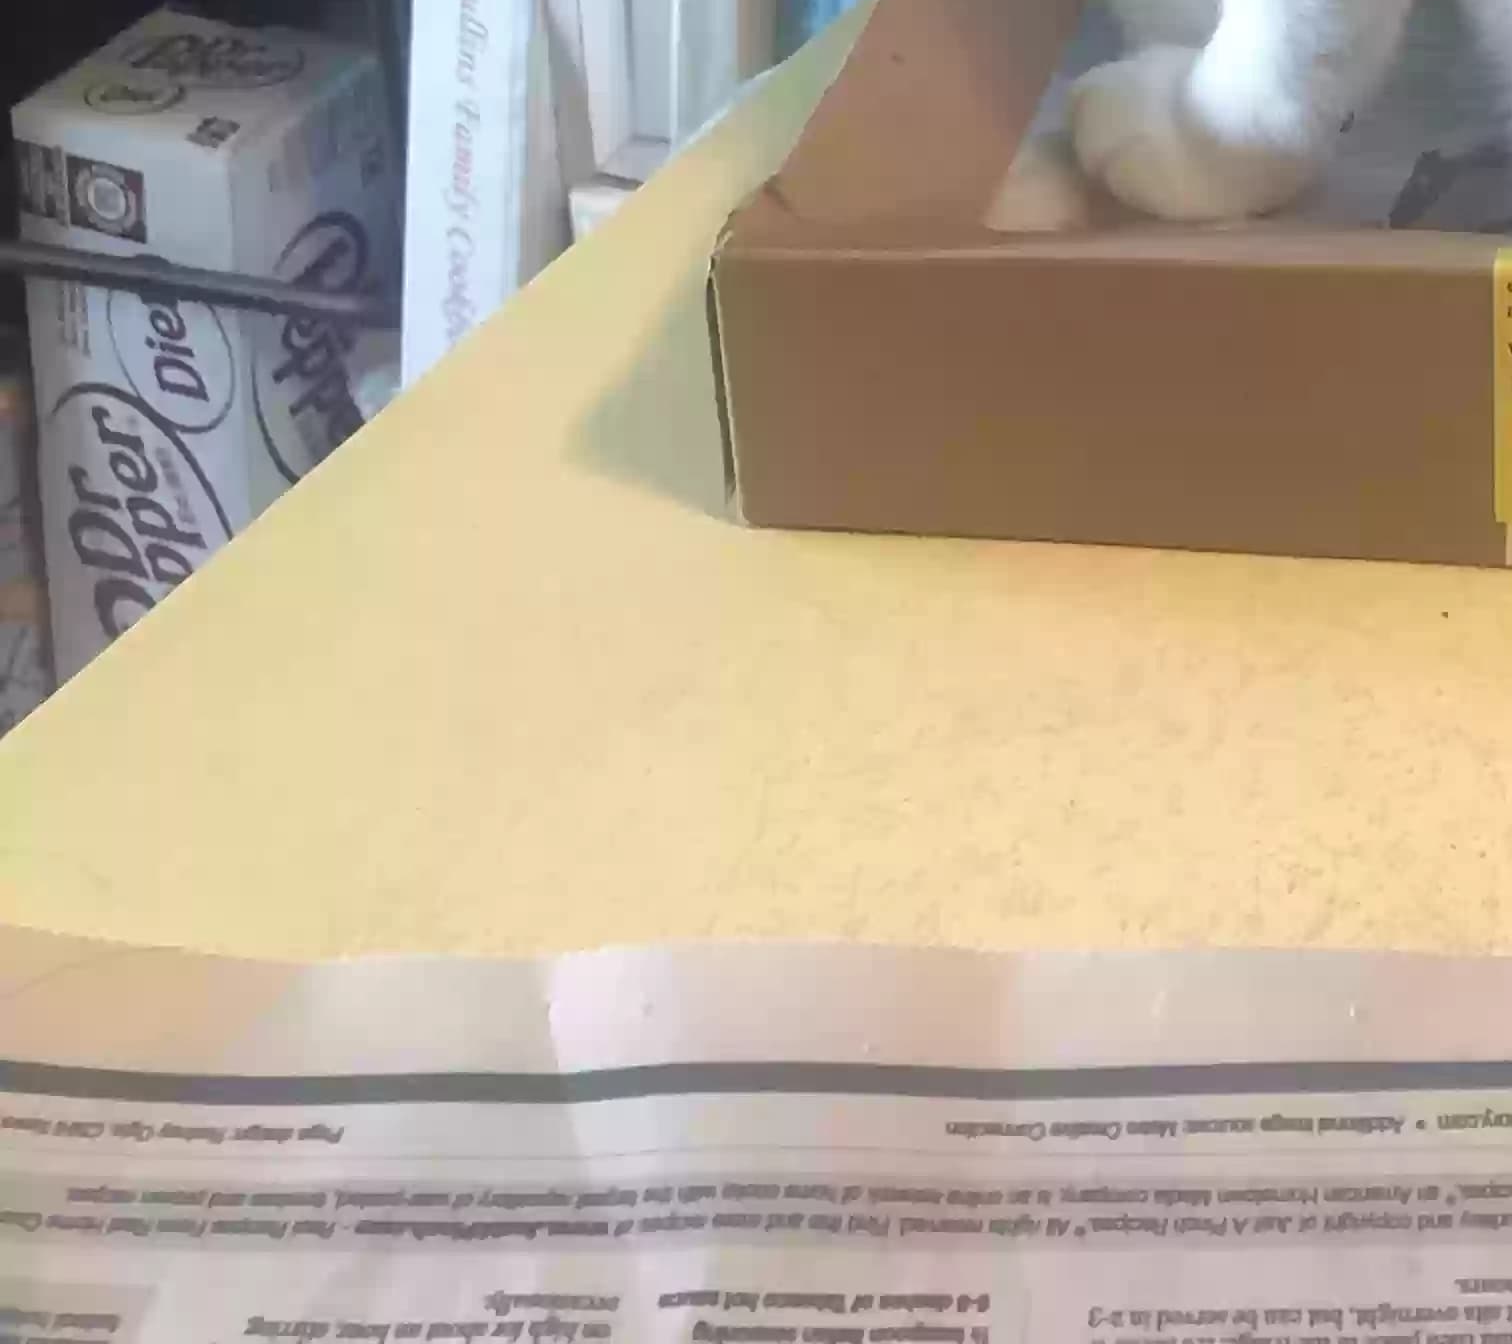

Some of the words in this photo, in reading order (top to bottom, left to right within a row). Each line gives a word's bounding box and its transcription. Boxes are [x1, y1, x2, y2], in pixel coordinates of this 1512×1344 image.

[442, 96, 481, 220] Family
[441, 226, 478, 348] Cookb
[144, 297, 210, 402] Die
[68, 464, 148, 581] Dr
